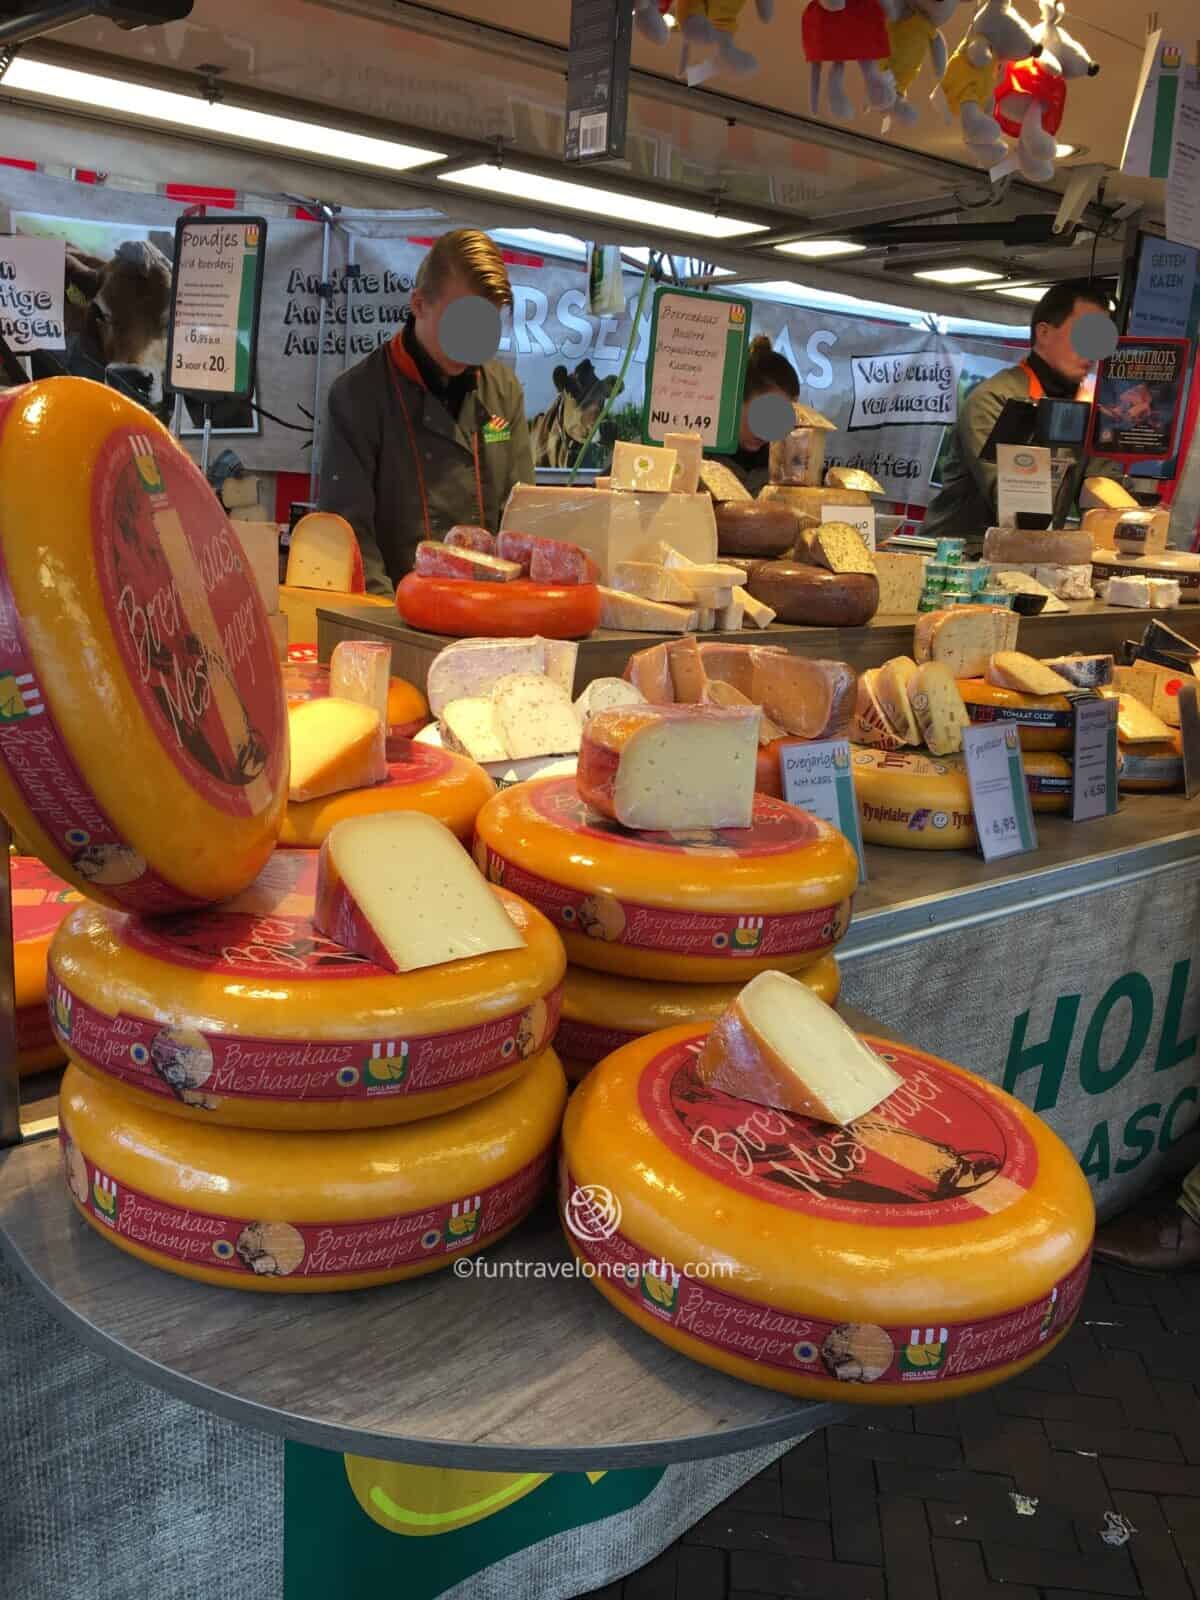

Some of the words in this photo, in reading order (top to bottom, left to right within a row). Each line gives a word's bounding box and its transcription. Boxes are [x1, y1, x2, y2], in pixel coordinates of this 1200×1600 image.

[182, 227, 239, 254] Pondjes
[175, 353, 183, 369] 3
[857, 360, 889, 384] Vol
[651, 410, 670, 424] NU
[683, 412, 711, 429] 1,49
